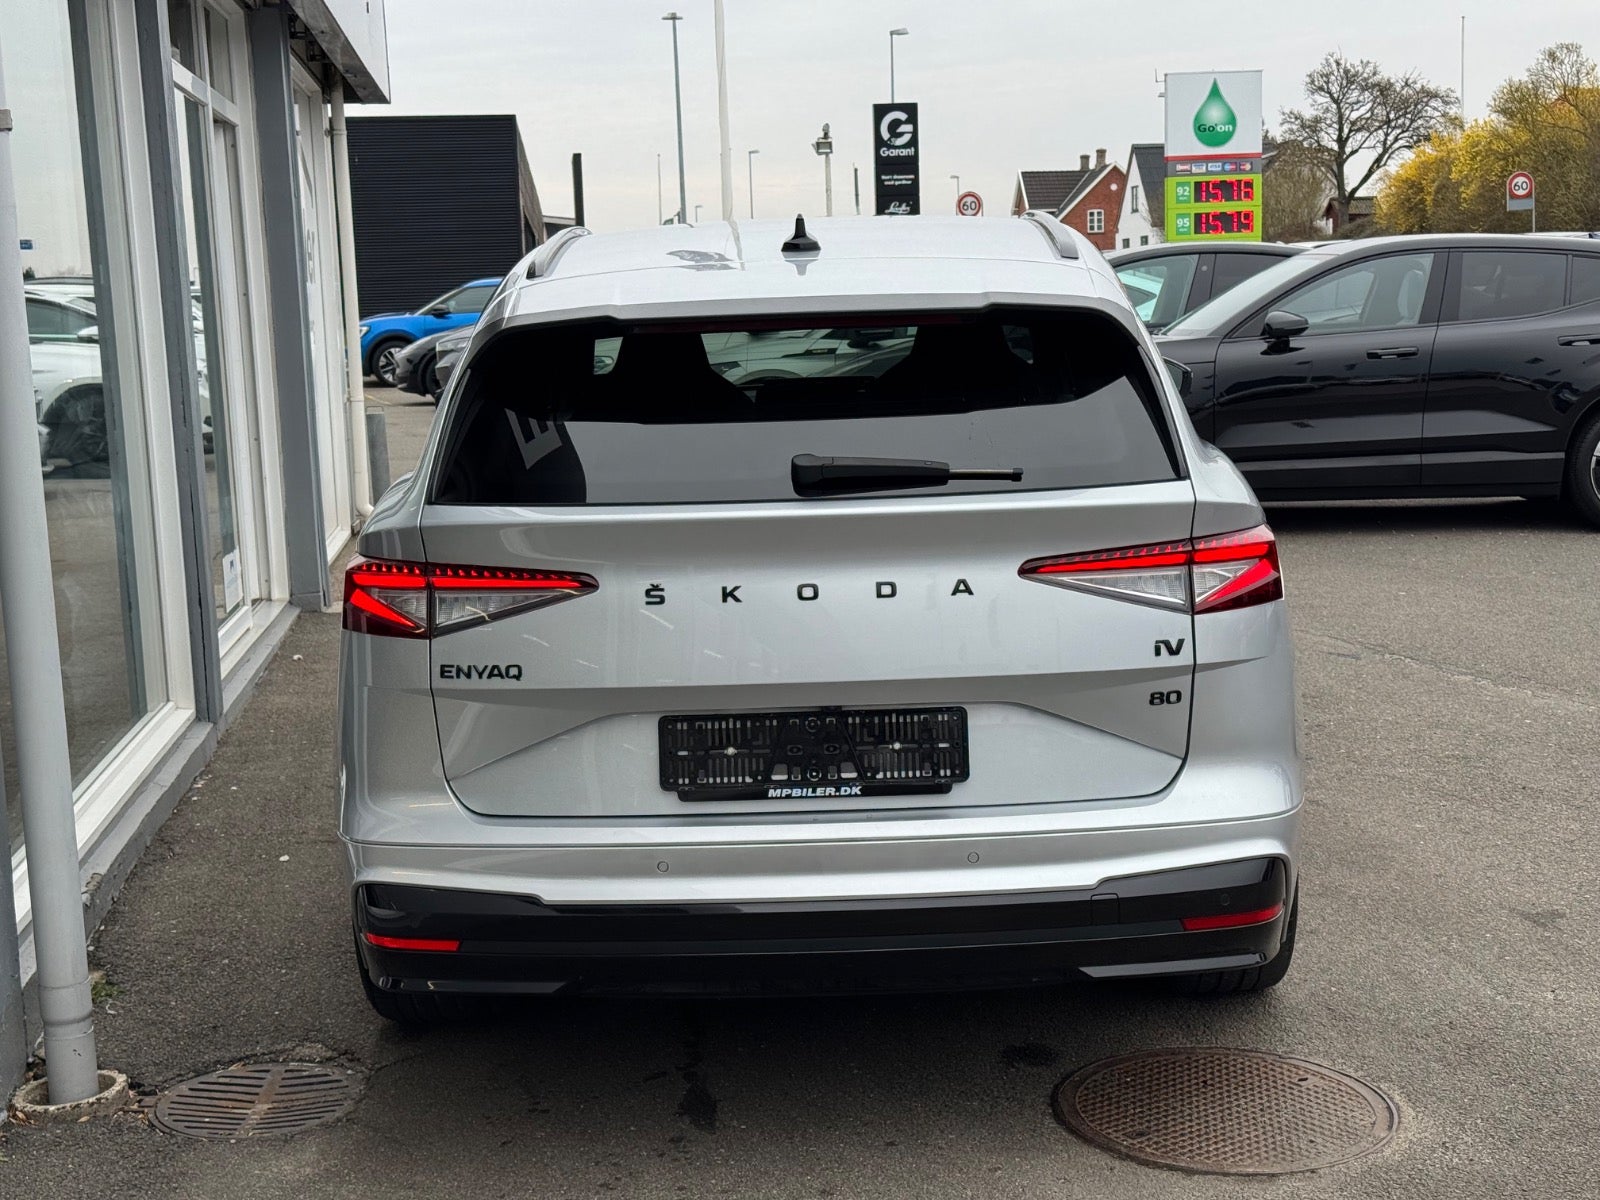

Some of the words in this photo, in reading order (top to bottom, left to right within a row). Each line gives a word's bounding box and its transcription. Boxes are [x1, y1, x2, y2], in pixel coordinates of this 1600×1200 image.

[880, 147, 915, 157] Garant
[1176, 186, 1190, 196] 92
[1513, 180, 1529, 191] 60
[961, 200, 977, 211] 60
[1176, 217, 1190, 228] 95
[644, 578, 974, 606] ŠKODA
[439, 664, 523, 681] ENYAQ
[1149, 690, 1182, 706] 80
[768, 786, 862, 798] MPBILER.DK
